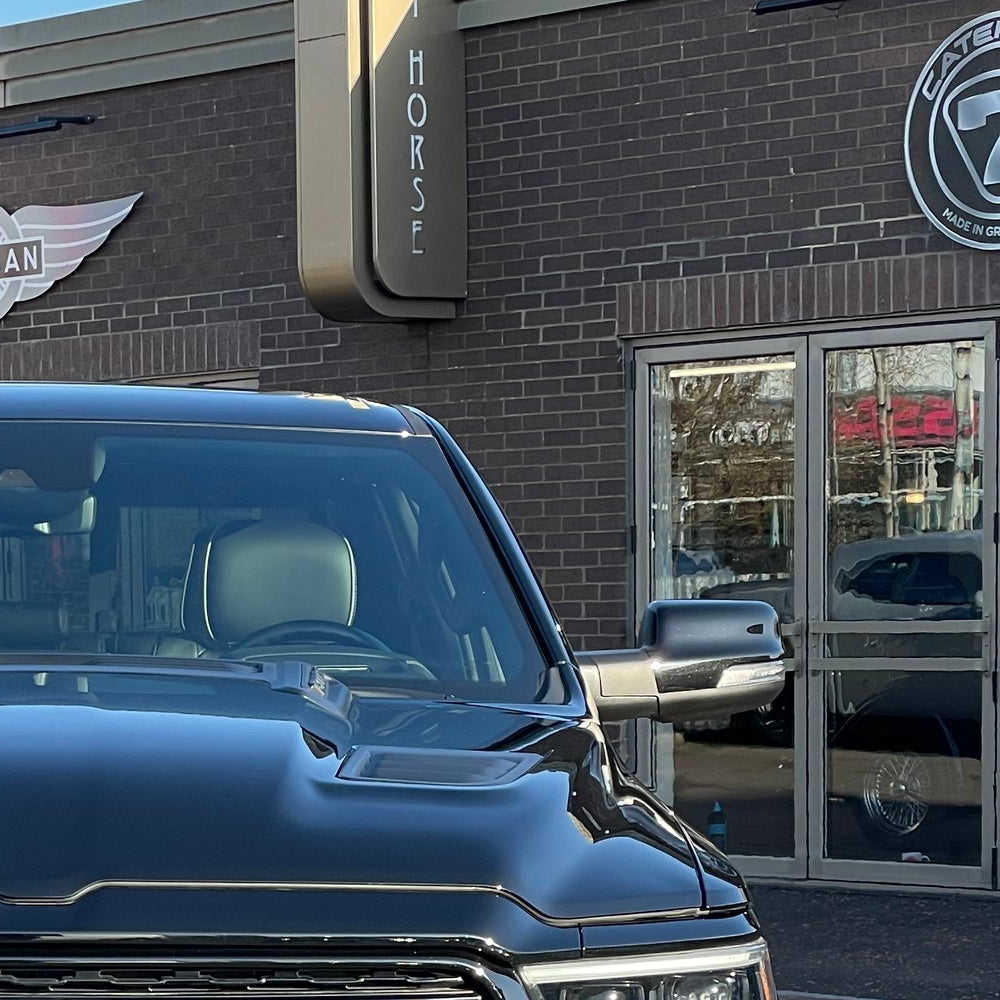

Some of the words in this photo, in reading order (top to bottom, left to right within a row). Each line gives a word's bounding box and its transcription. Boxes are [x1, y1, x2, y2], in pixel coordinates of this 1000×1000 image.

[922, 20, 1000, 100] CATE
[407, 49, 428, 254] HORSE
[942, 207, 973, 232] MADE
[971, 223, 985, 236] IN
